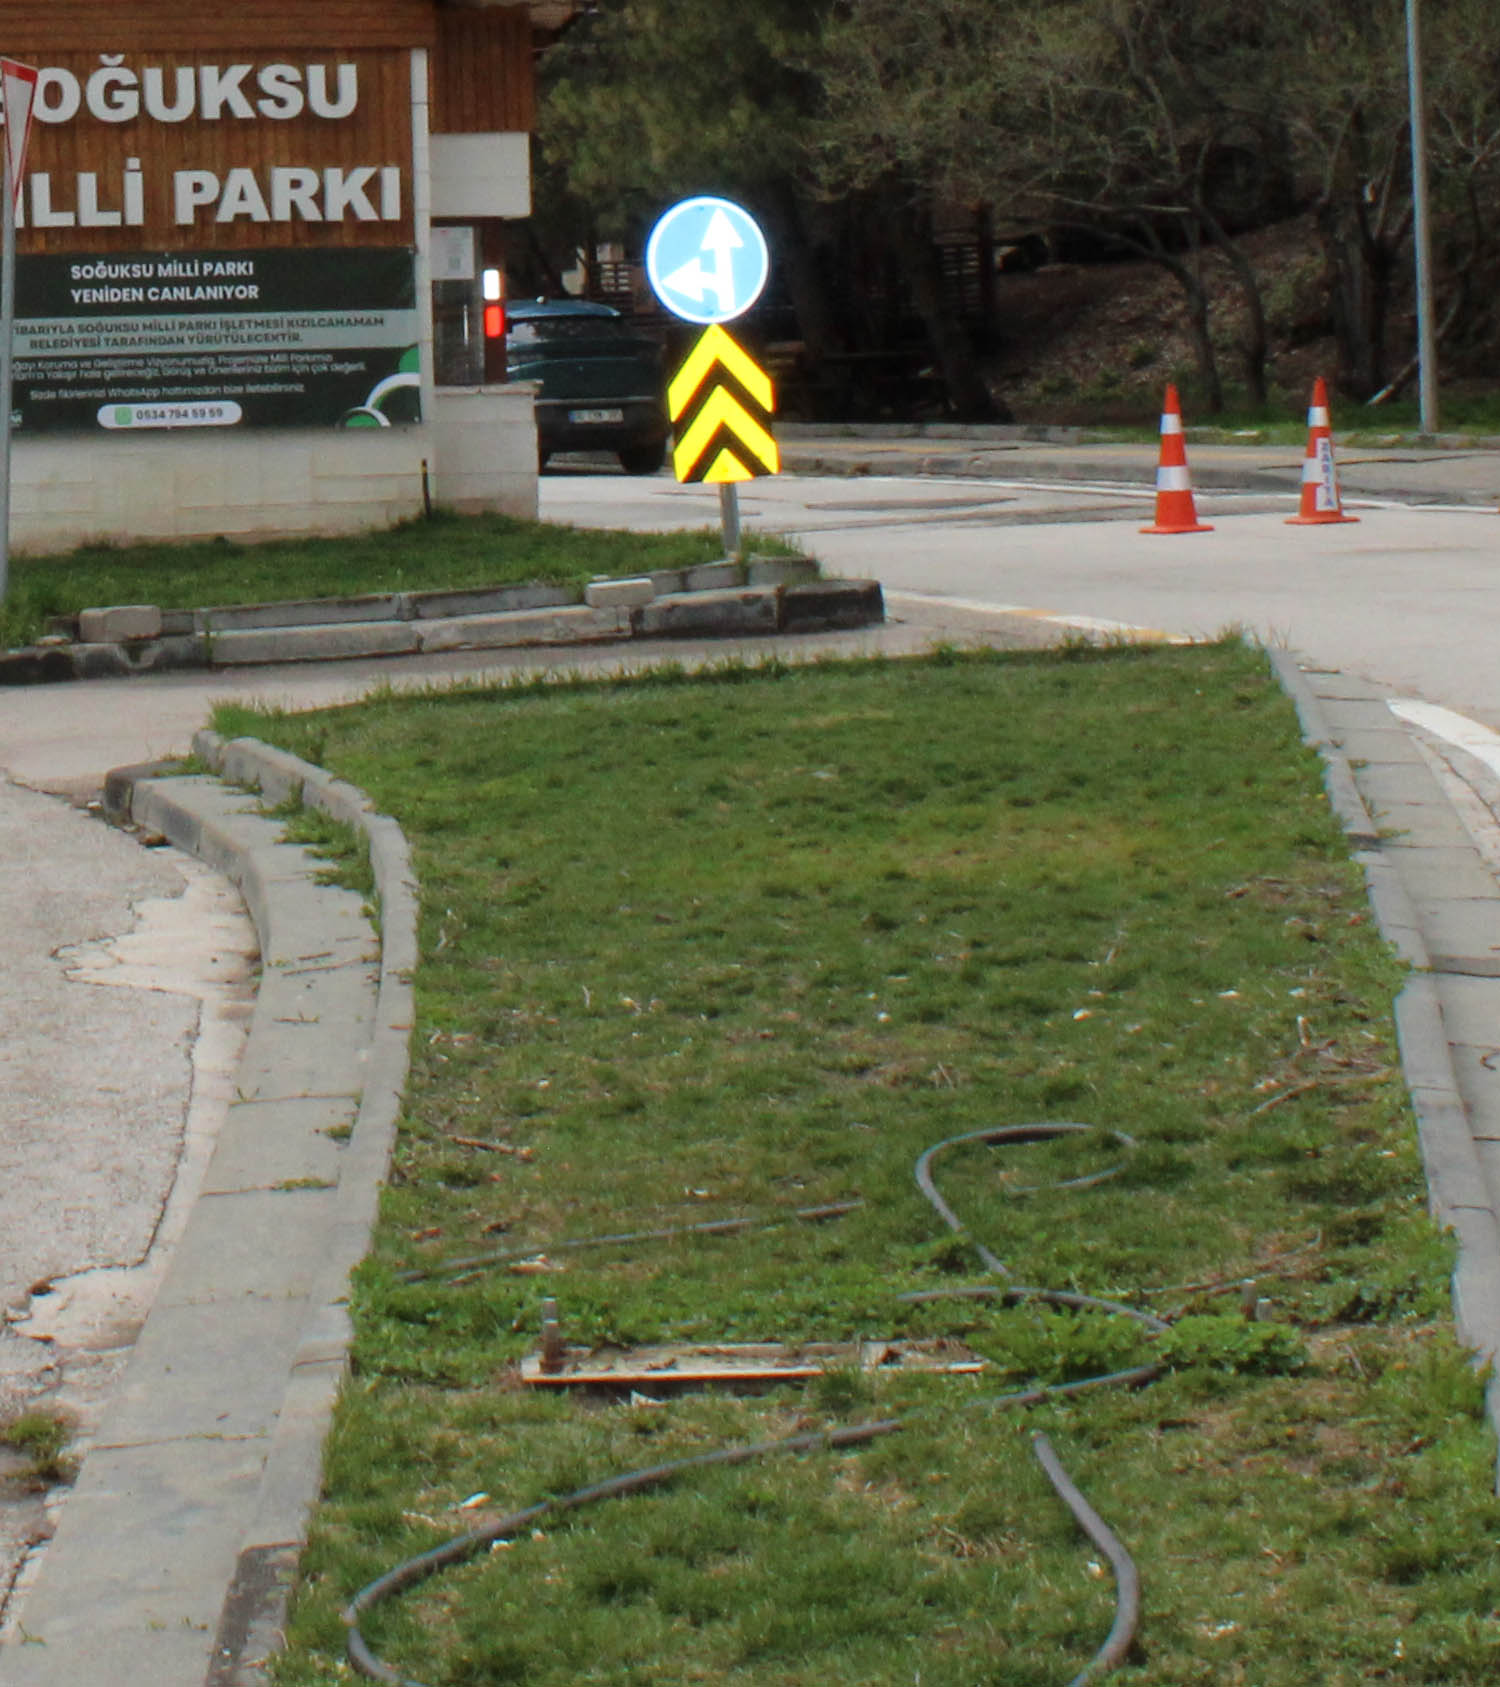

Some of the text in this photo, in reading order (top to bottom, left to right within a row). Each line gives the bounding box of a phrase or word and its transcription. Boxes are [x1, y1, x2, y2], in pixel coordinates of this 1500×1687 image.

[174, 167, 400, 226] PARKI
[71, 259, 254, 279] SOĞUKSU MİLLİ PARKI
[71, 284, 259, 303] YENİDEN CANLANIYOR
[78, 322, 139, 334] SOĞUKSU
[142, 320, 175, 333] MİLLİ
[178, 320, 216, 331] PARKI
[220, 316, 284, 332] İŞLETMESİ
[287, 316, 384, 328] KIZILCAHAMAM
[30, 335, 99, 350] BELEDİYESİ
[105, 335, 184, 348] TARAFINDAN
[136, 409, 166, 420] 0534
